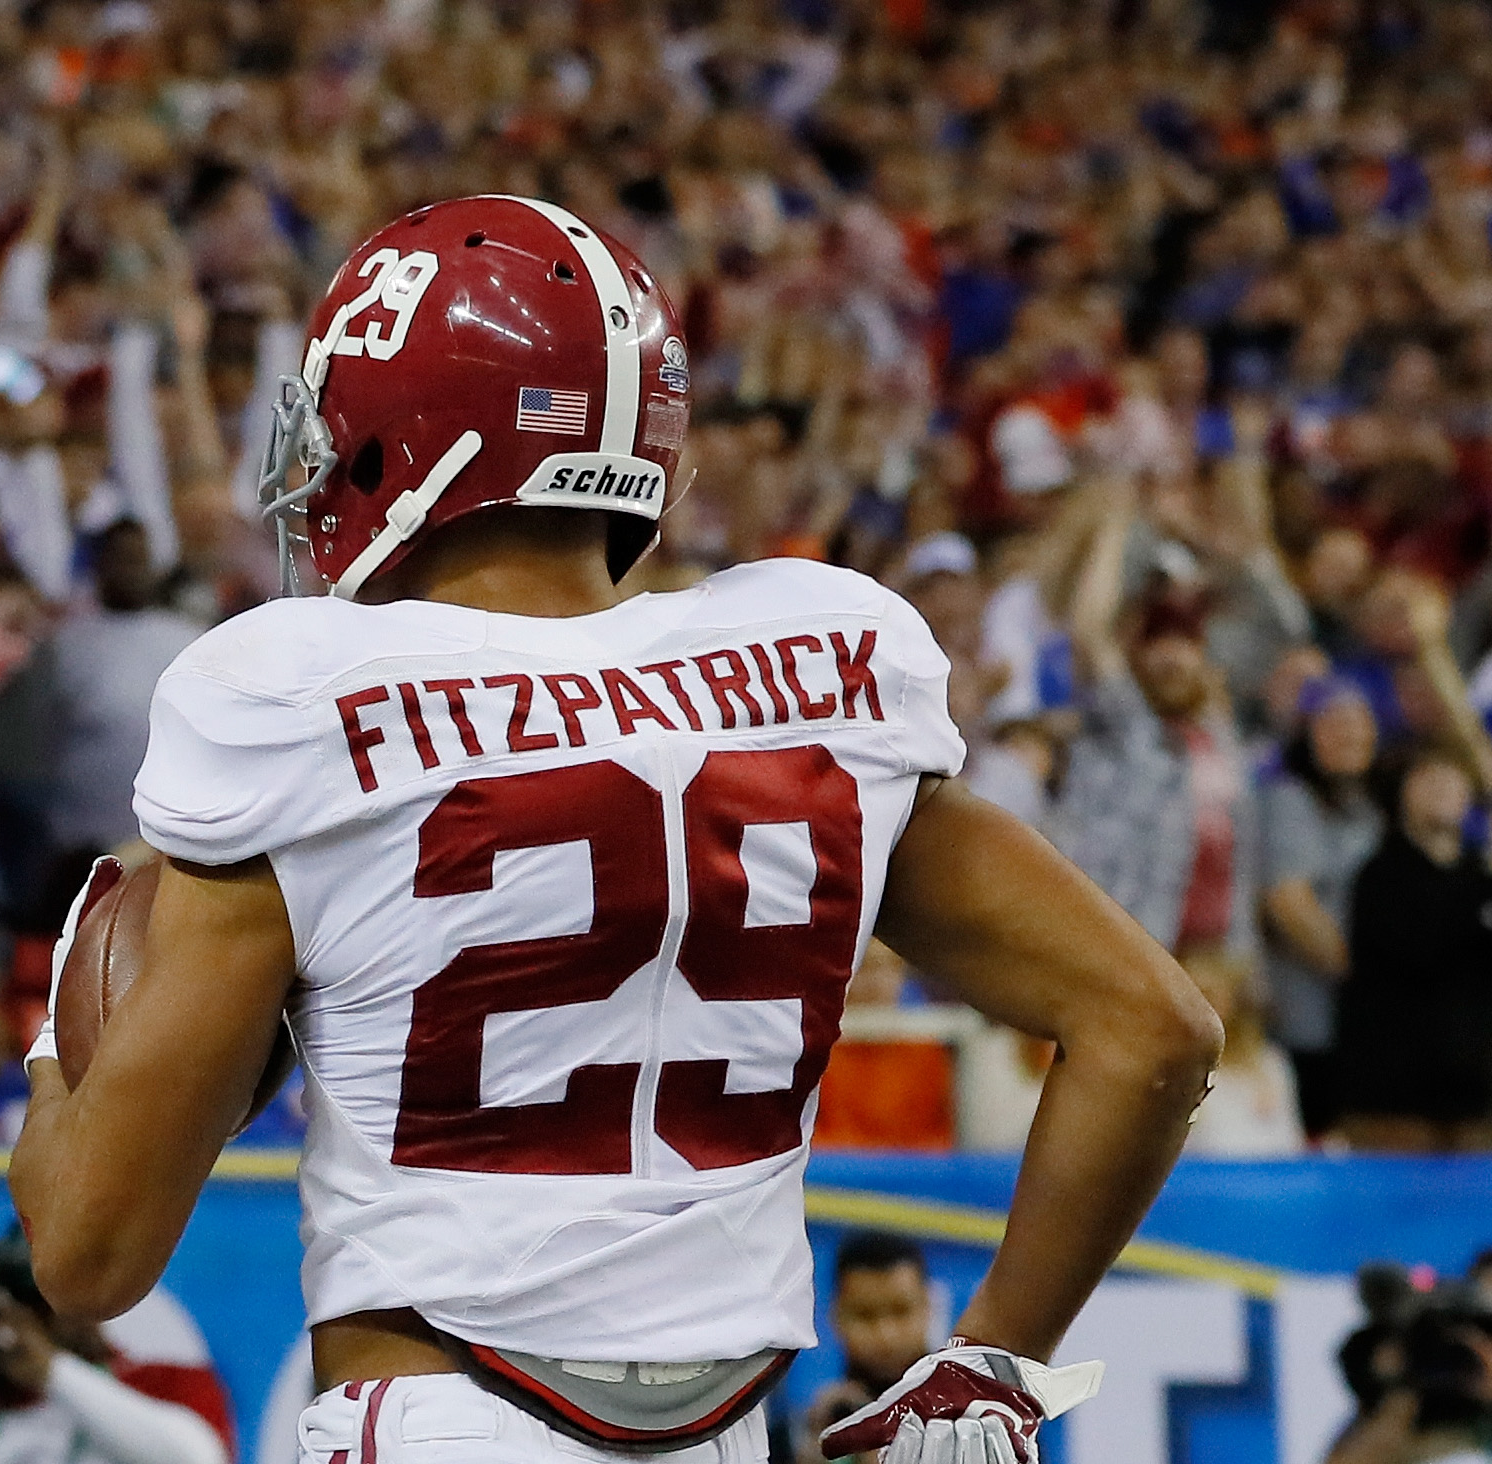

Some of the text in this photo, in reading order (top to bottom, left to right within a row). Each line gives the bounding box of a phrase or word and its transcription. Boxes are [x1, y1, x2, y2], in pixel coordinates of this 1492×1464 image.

[332, 247, 440, 361] 29
[335, 629, 884, 793] FITZPATRICK
[391, 744, 863, 1175] 29
